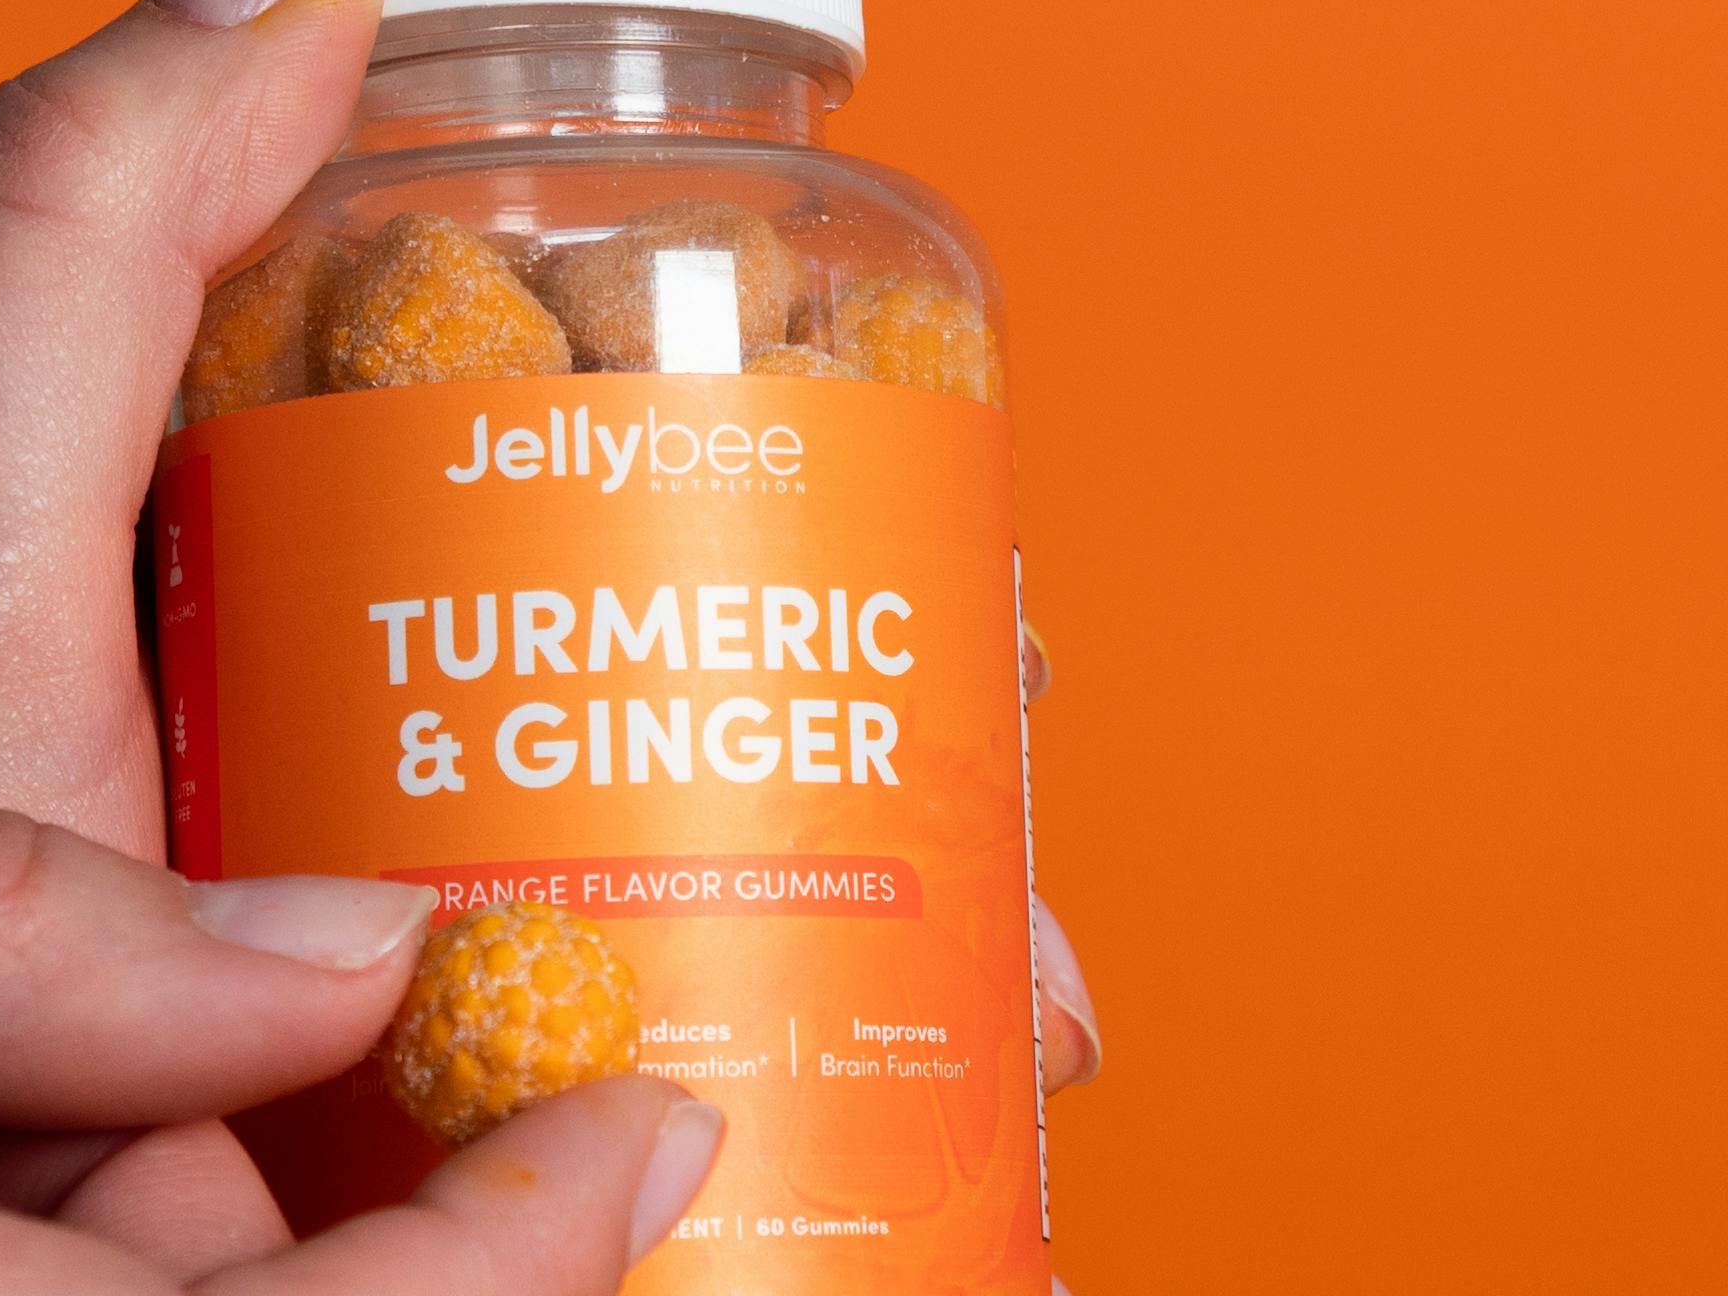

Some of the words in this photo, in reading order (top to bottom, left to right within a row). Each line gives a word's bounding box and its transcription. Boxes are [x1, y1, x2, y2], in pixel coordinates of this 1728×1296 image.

[444, 405, 804, 494] Jellybee
[650, 478, 806, 495] NUTRITION
[369, 585, 915, 686] TURMERIC
[397, 710, 466, 797] &
[494, 696, 901, 790] GINGER
[583, 870, 722, 903] FLAVOR
[734, 870, 896, 903] GUMMIES
[639, 1018, 732, 1044] educes
[853, 1017, 947, 1047] Improves
[821, 1054, 880, 1077] Brain
[756, 1217, 785, 1237] 60
[791, 1215, 889, 1236] Gummies
